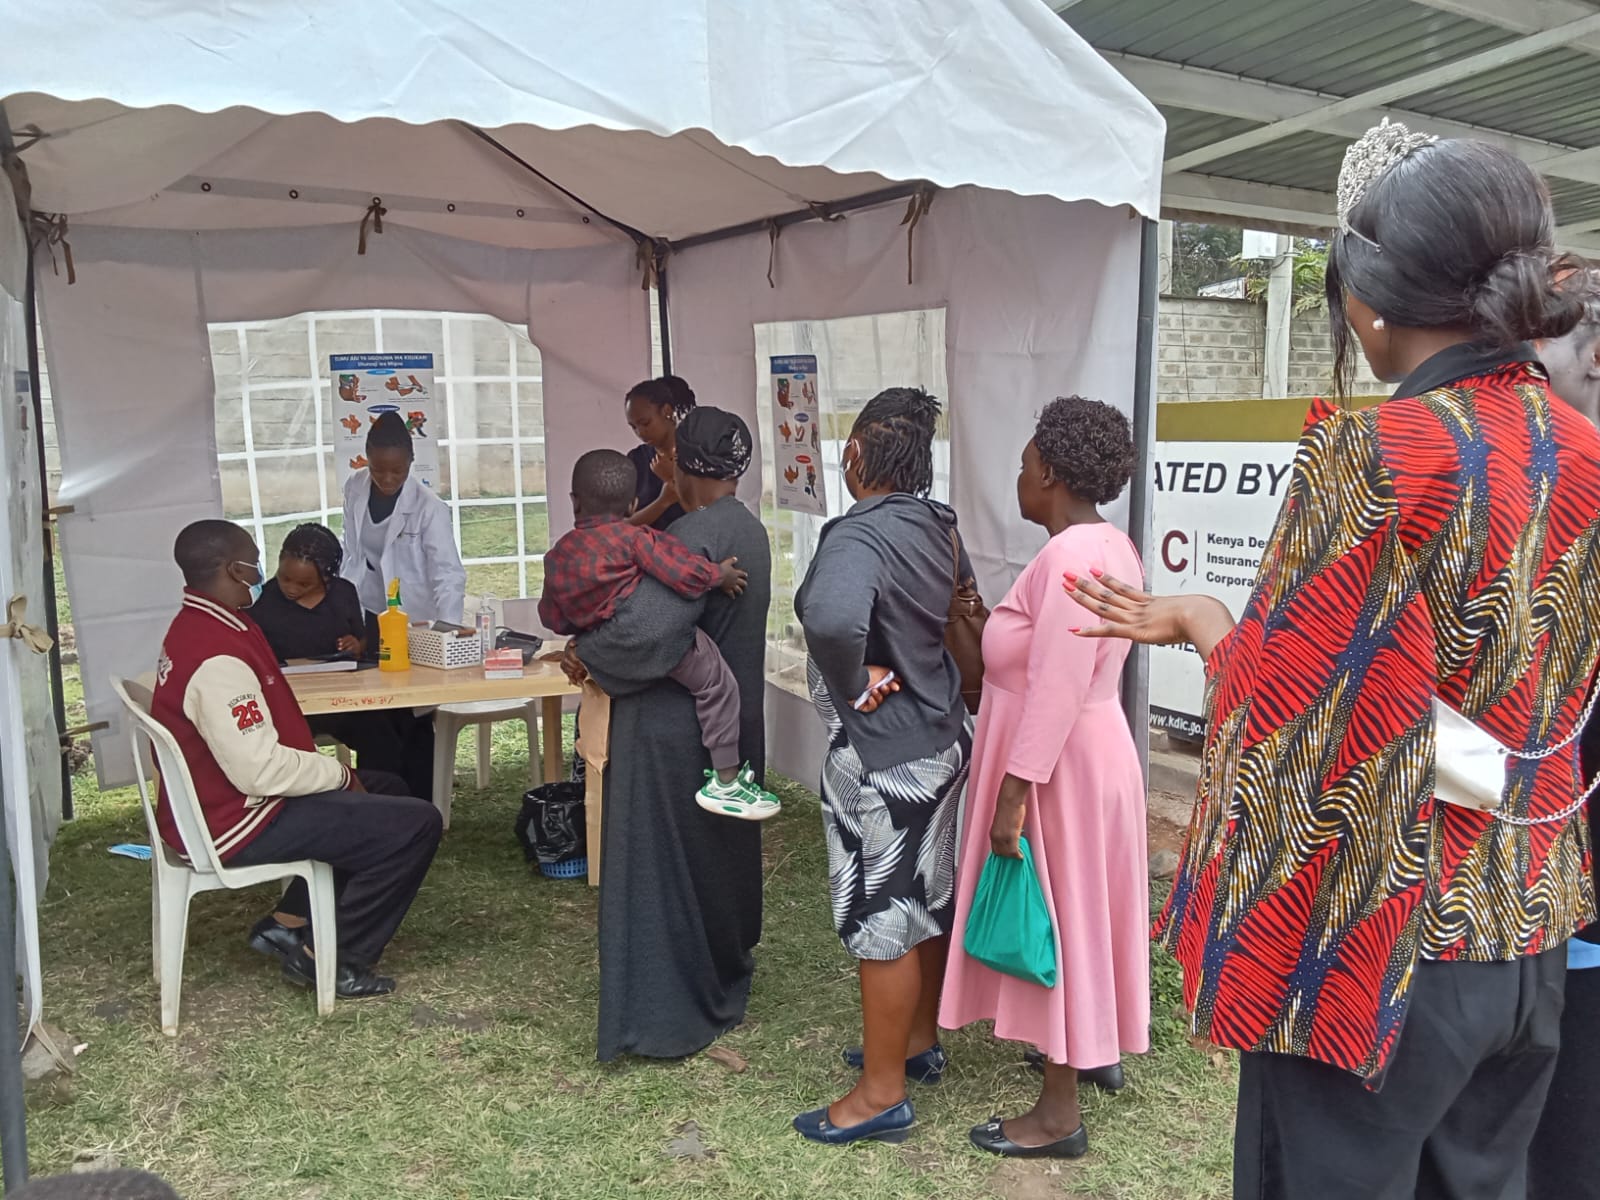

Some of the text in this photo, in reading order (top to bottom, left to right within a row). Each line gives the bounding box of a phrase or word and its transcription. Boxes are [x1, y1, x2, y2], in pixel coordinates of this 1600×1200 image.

[1236, 463, 1291, 496] BY
[1207, 533, 1244, 548] Kenya
[232, 700, 264, 731] 26
